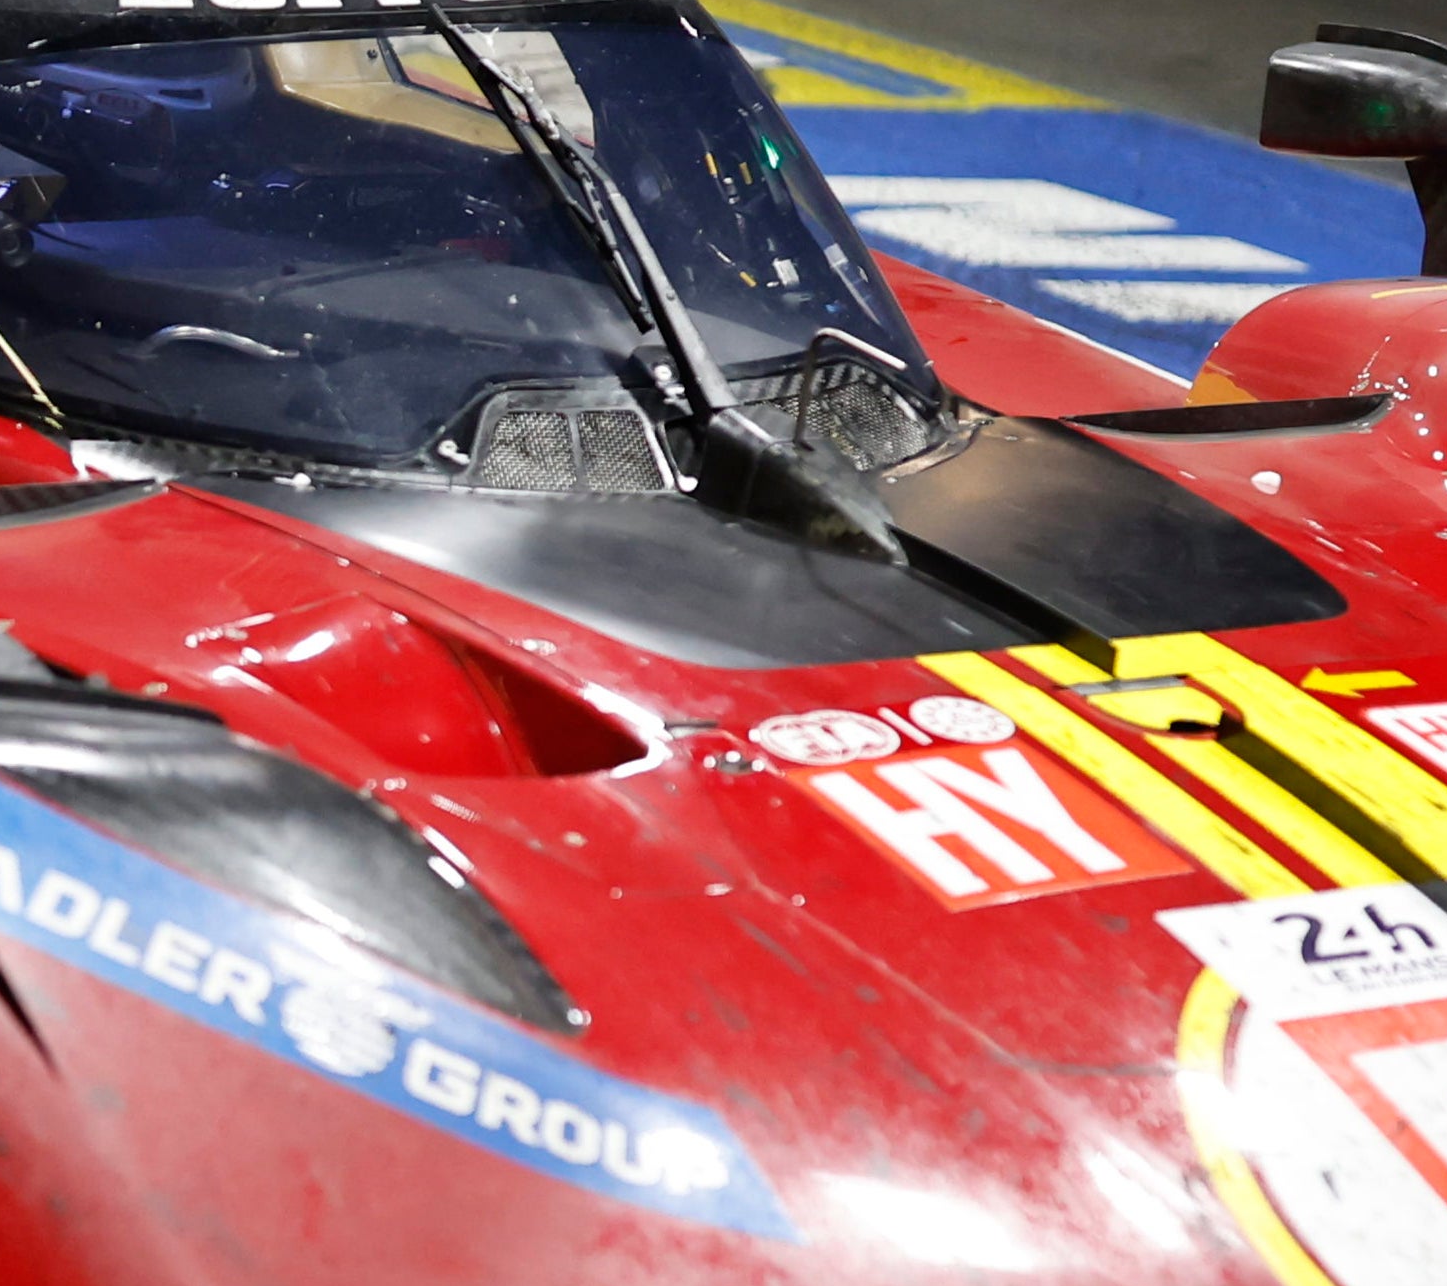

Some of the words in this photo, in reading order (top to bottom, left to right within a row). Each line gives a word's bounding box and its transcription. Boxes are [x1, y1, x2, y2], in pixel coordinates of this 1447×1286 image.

[809, 746, 1128, 898] HY
[1271, 902, 1439, 965] 24h
[1312, 963, 1357, 986] LE
[401, 1035, 732, 1198] GROUP
